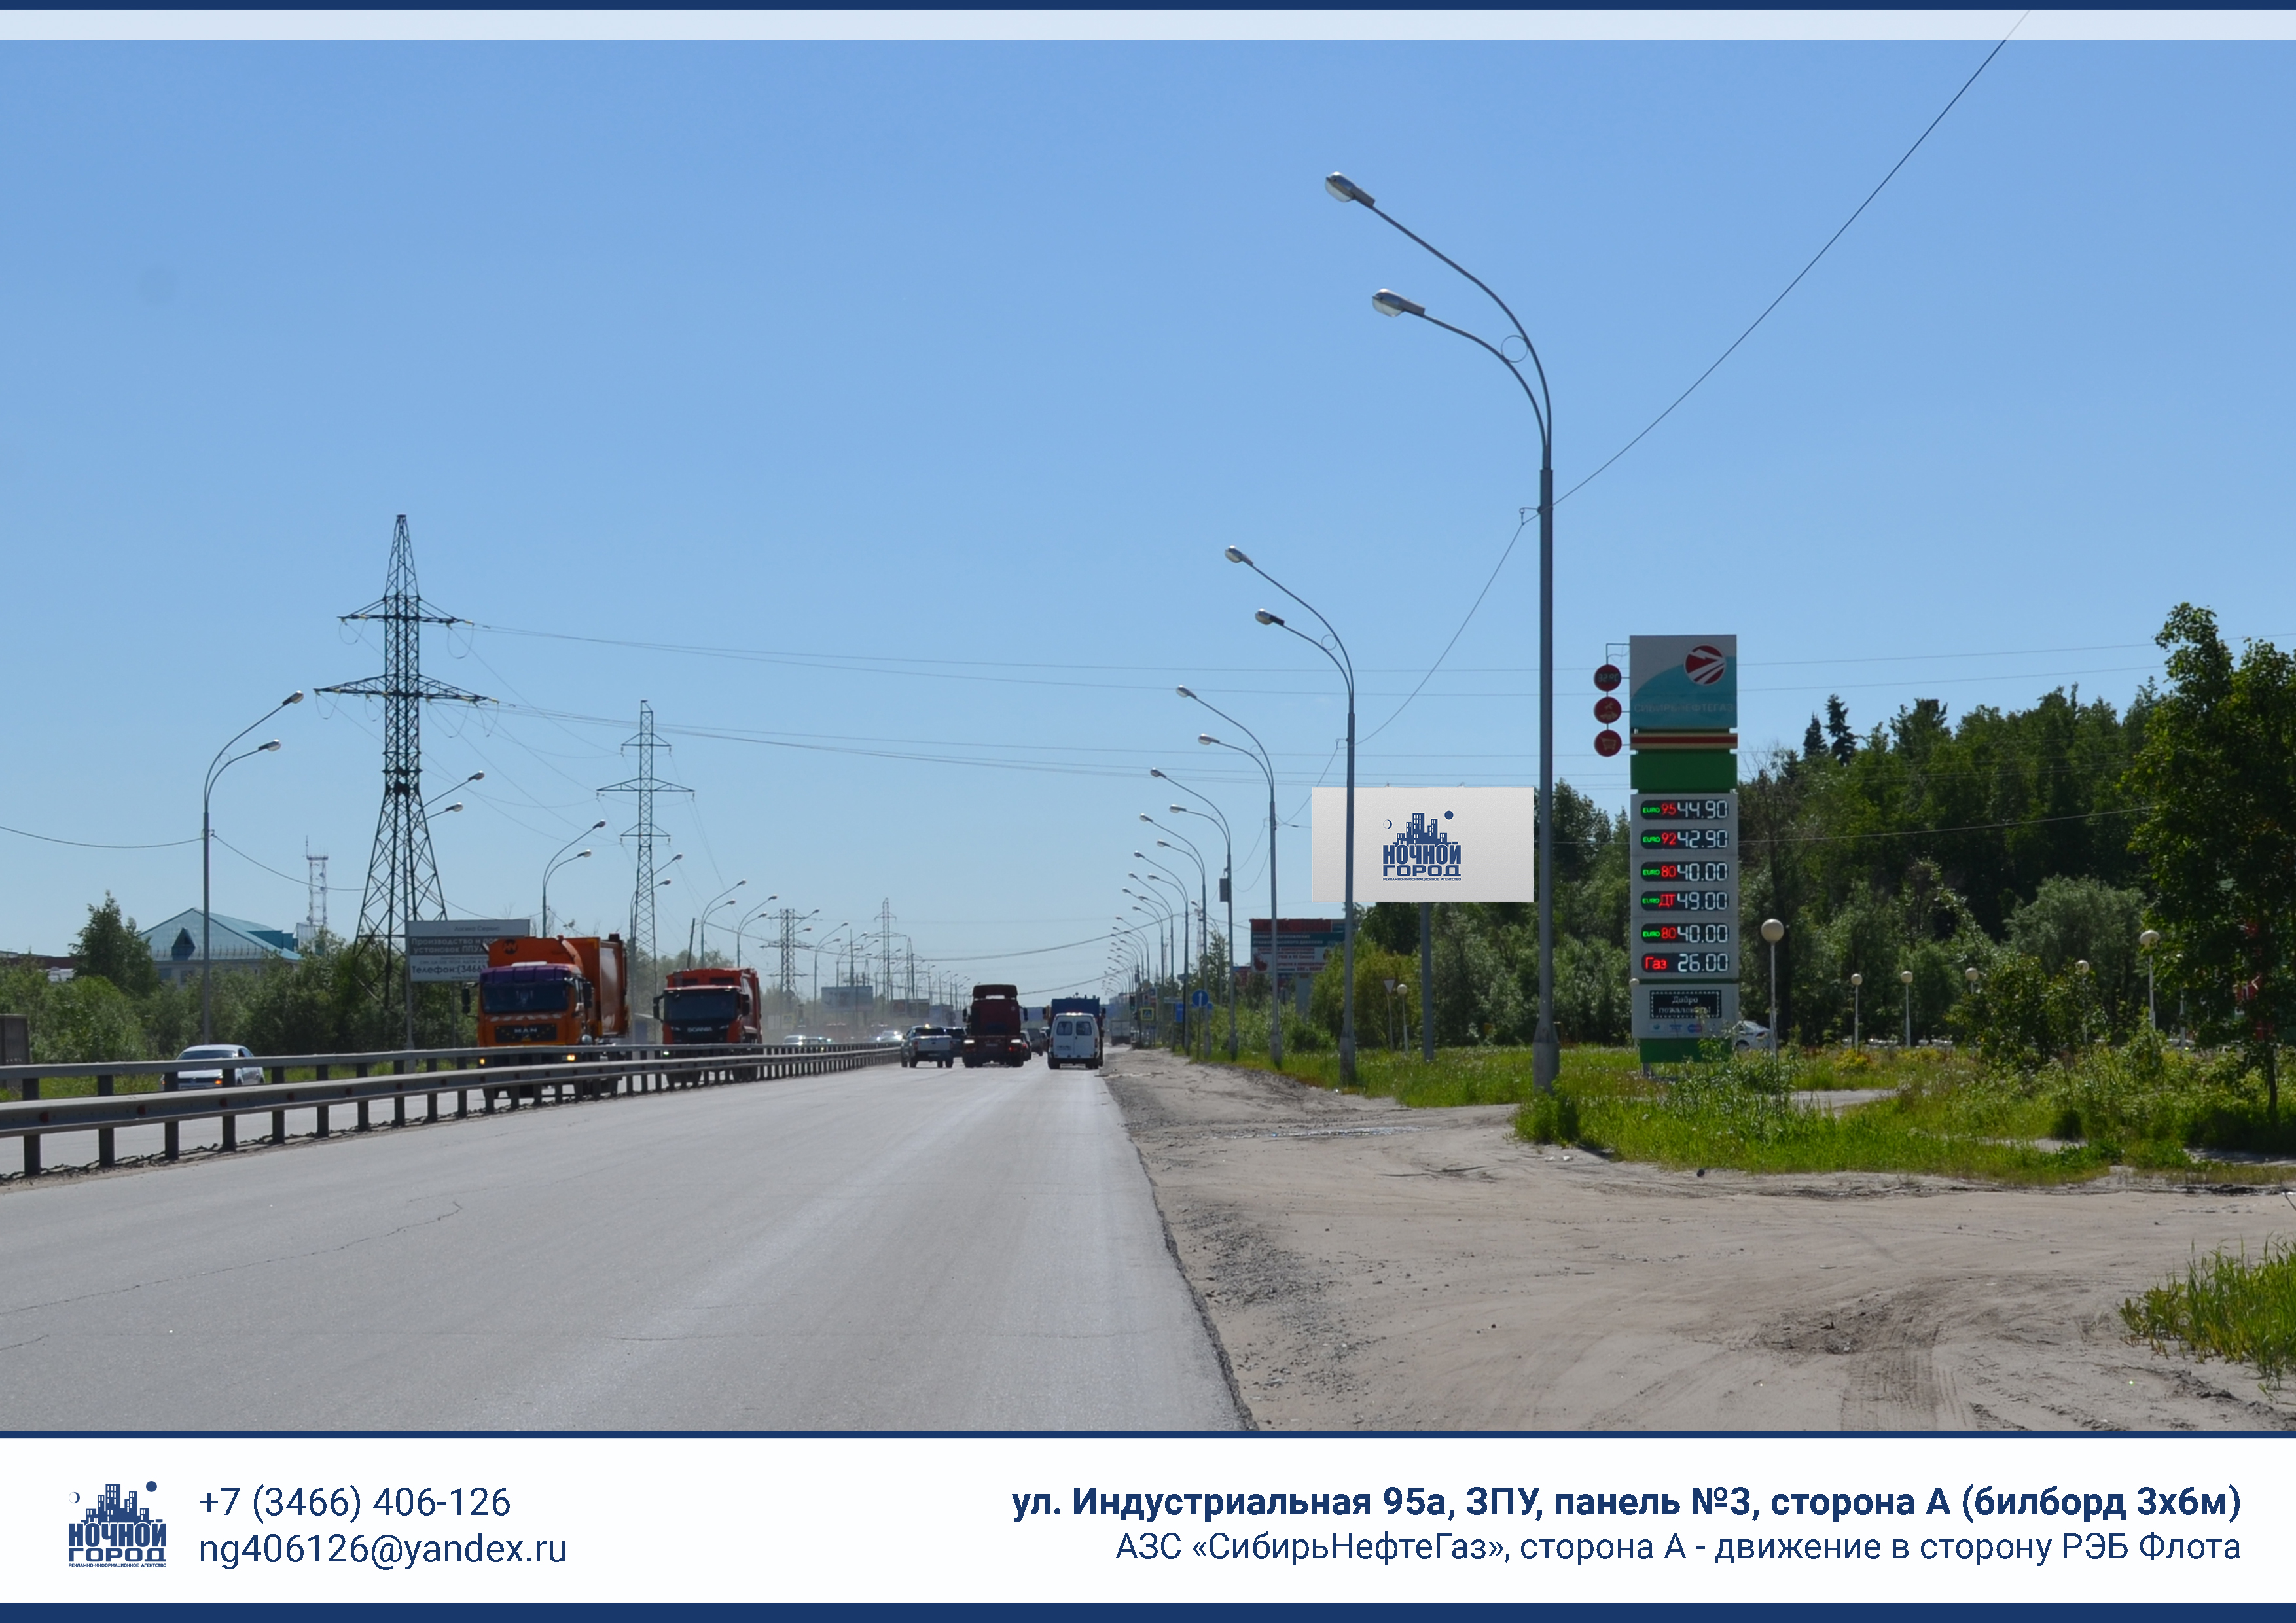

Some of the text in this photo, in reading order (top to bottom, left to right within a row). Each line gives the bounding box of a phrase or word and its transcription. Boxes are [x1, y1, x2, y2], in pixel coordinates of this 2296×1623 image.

[1634, 703, 1734, 713] СИБИРЬНЕФТЕГАЗ
[1661, 802, 1677, 815] 95
[1677, 800, 1727, 819] 44.90
[1661, 832, 1677, 846] 92
[1677, 830, 1727, 848] 42.90
[1383, 842, 1462, 865] НОЧНОЙ
[1383, 865, 1462, 877] ГОРОД
[1661, 865, 1677, 878] 80
[1677, 863, 1727, 882] 40.00
[1659, 894, 1676, 908] ДТ
[1677, 891, 1727, 910] 49.00
[411, 938, 473, 946] Производство
[1661, 927, 1677, 939] 80
[1677, 925, 1728, 943] 40.00
[1645, 954, 1729, 972] Газ 26.00
